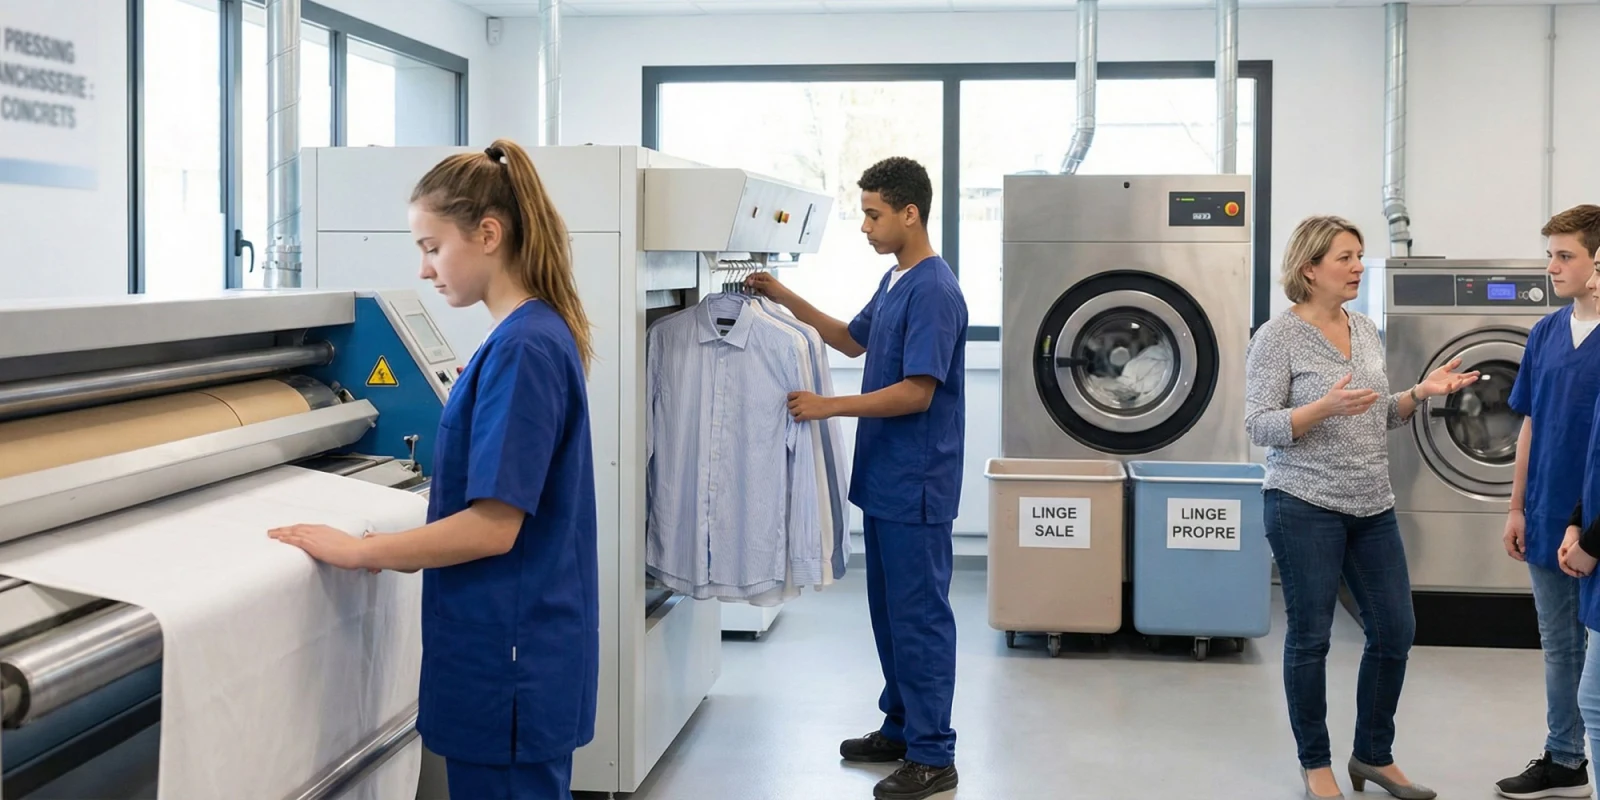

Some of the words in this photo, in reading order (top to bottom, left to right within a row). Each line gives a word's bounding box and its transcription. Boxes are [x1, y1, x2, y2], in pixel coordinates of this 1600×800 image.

[4, 27, 75, 65] PRESSING
[1, 97, 76, 130] CONCRETS
[1032, 506, 1077, 520] LINGE
[1181, 507, 1227, 521] LINGE
[1034, 524, 1075, 538] SALE
[1172, 526, 1236, 540] PROPRE
